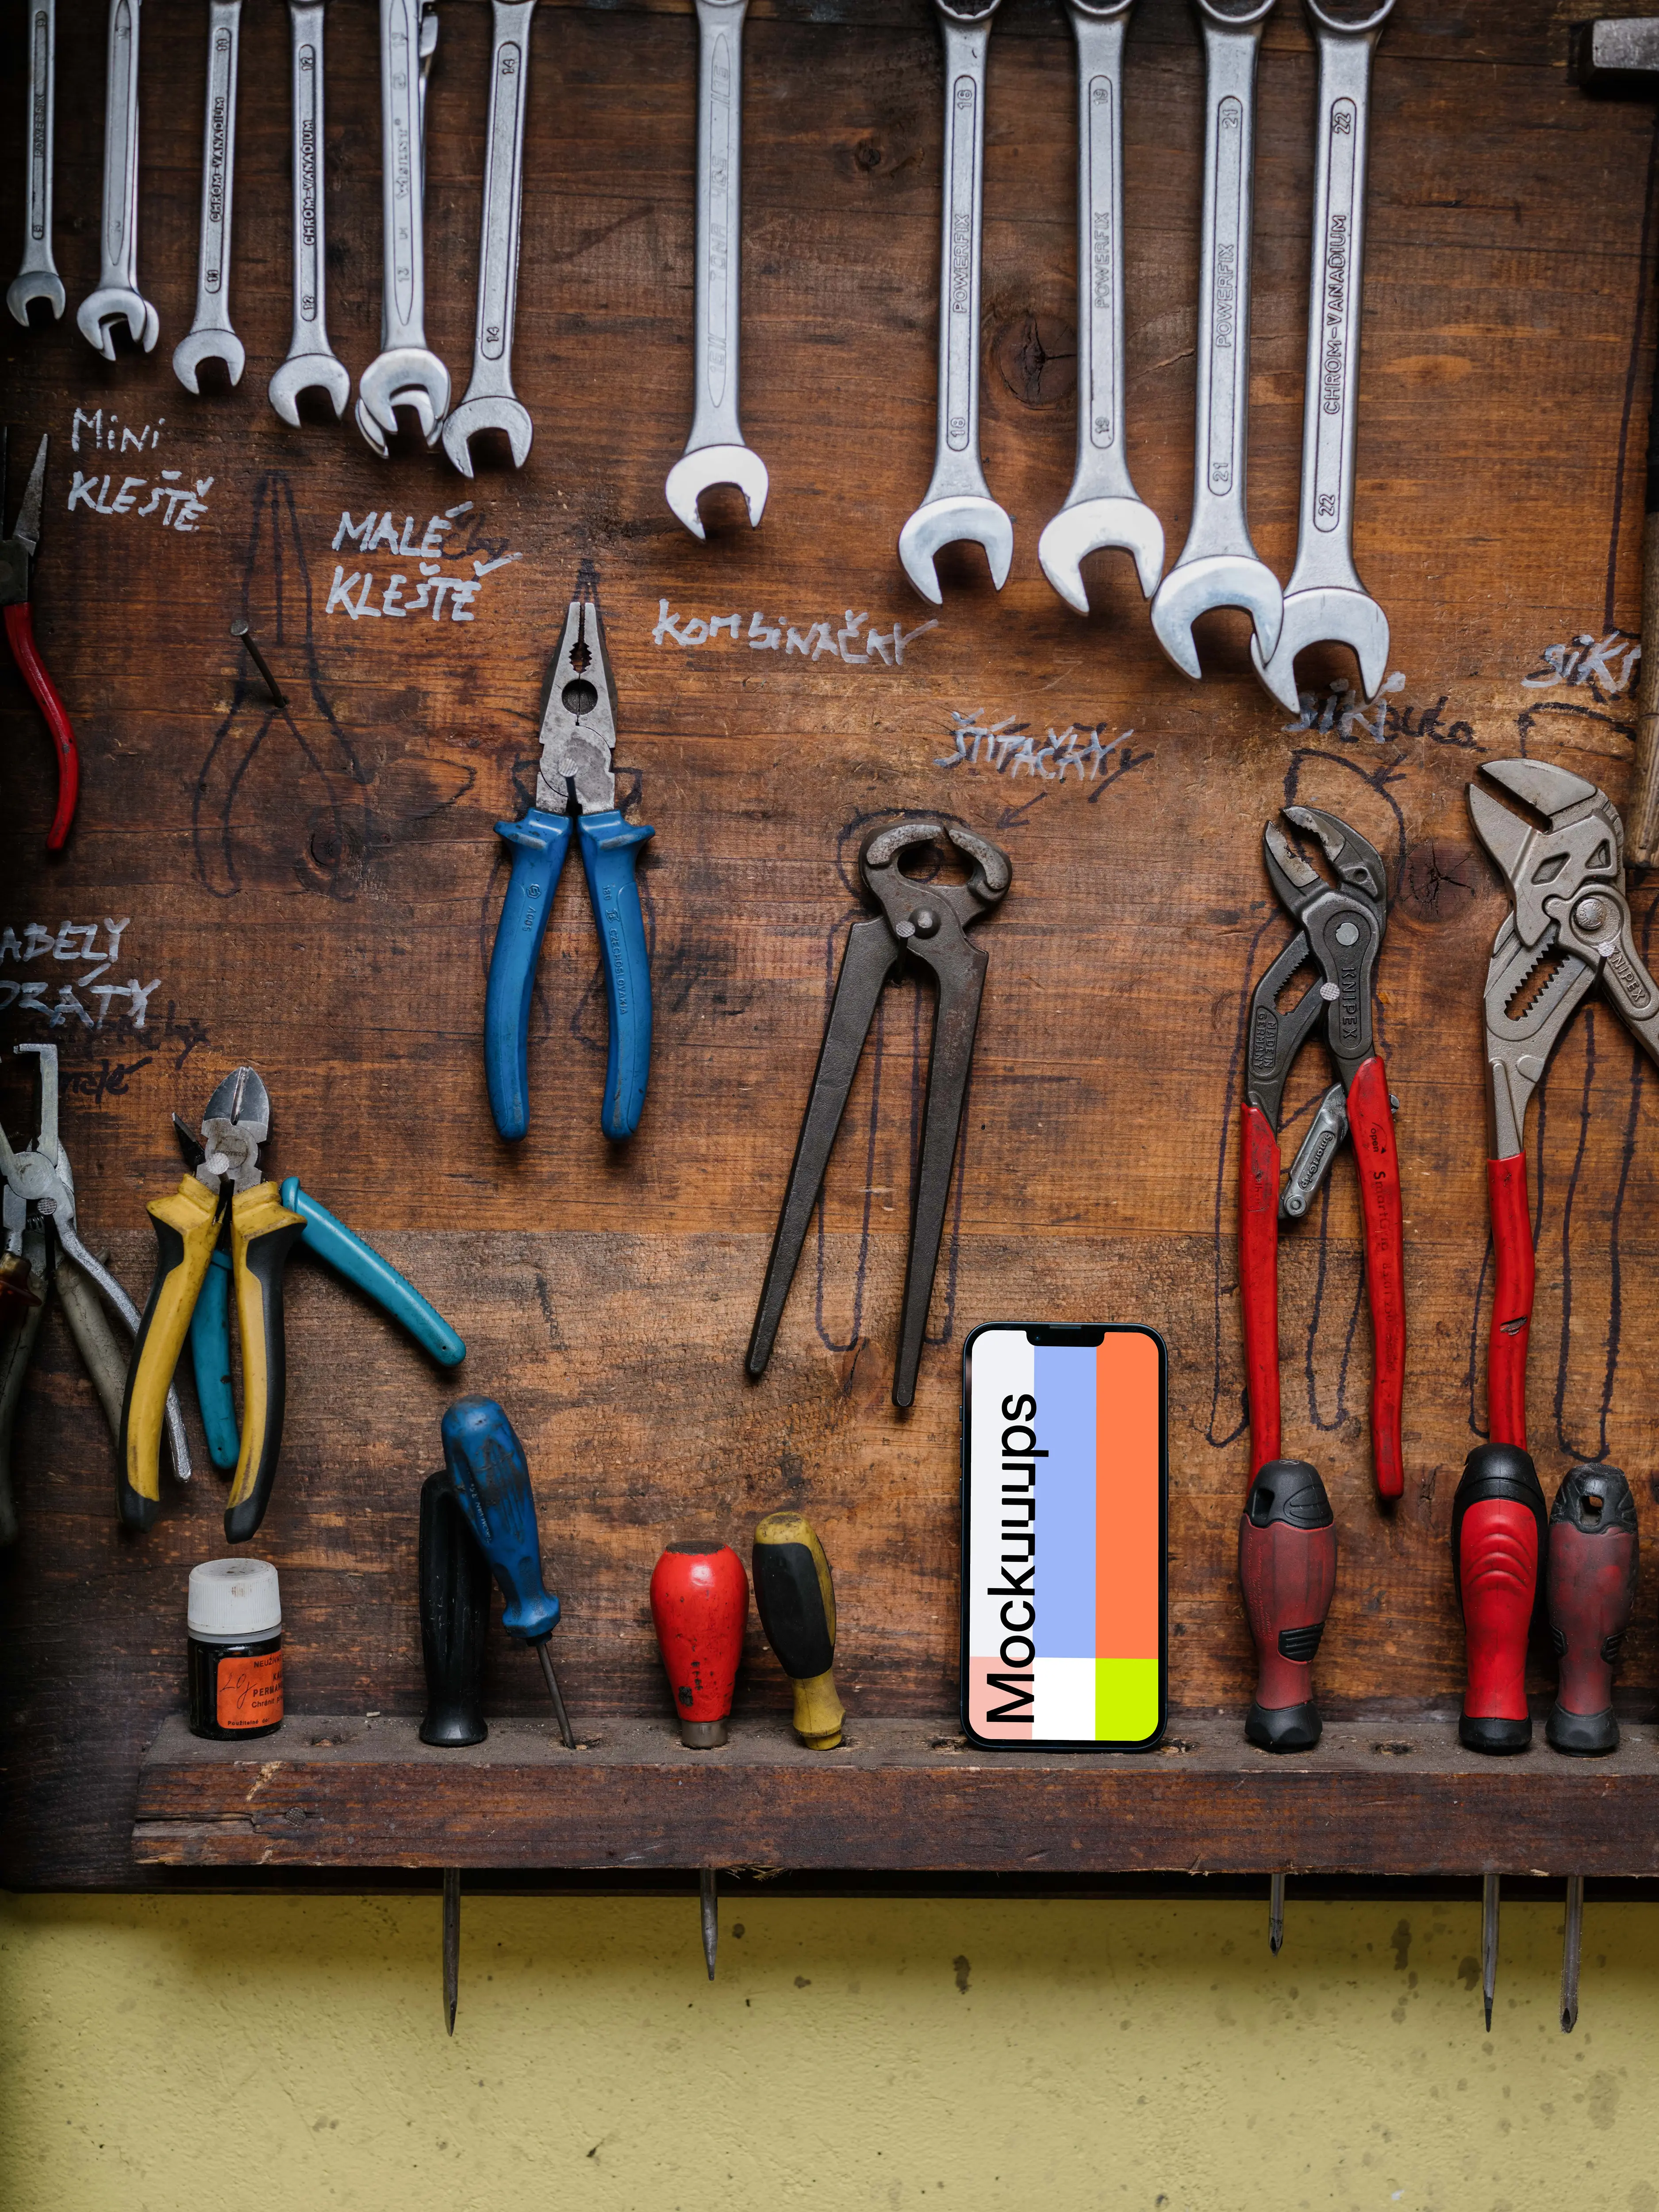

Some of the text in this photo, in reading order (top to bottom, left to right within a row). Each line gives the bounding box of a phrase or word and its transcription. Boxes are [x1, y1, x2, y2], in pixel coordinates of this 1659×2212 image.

[216, 38, 228, 51] 11
[301, 57, 313, 71] 12
[503, 58, 515, 75] 14
[957, 89, 972, 110] 18
[1093, 88, 1109, 106] 19
[1222, 105, 1238, 128] 21
[1333, 112, 1351, 134] 22
[211, 97, 224, 222] CHROM-VANADIUM
[303, 120, 315, 246] CHROM-VANADIUM
[952, 213, 970, 314] POWERFIX
[1094, 212, 1110, 309] POWERFIX
[207, 269, 218, 282] 11
[303, 296, 314, 310] 12
[1216, 242, 1236, 349] POWERFIX
[1323, 214, 1347, 415] CHROM-VANADIUM
[487, 326, 499, 342] 14
[951, 416, 966, 438] 18
[1095, 416, 1110, 435] 19
[1212, 461, 1229, 483] 21
[1318, 493, 1336, 517] 22
[610, 926, 629, 1016] CZECHOSLOVAKIA
[1341, 966, 1357, 1039] KNIPEX
[1255, 1013, 1267, 1070] GERMANY
[1264, 1022, 1277, 1069] MADE IN
[1370, 1128, 1379, 1153] open
[1299, 1131, 1333, 1190] SmartGrip
[986, 1393, 1049, 1724] Mockuuups
